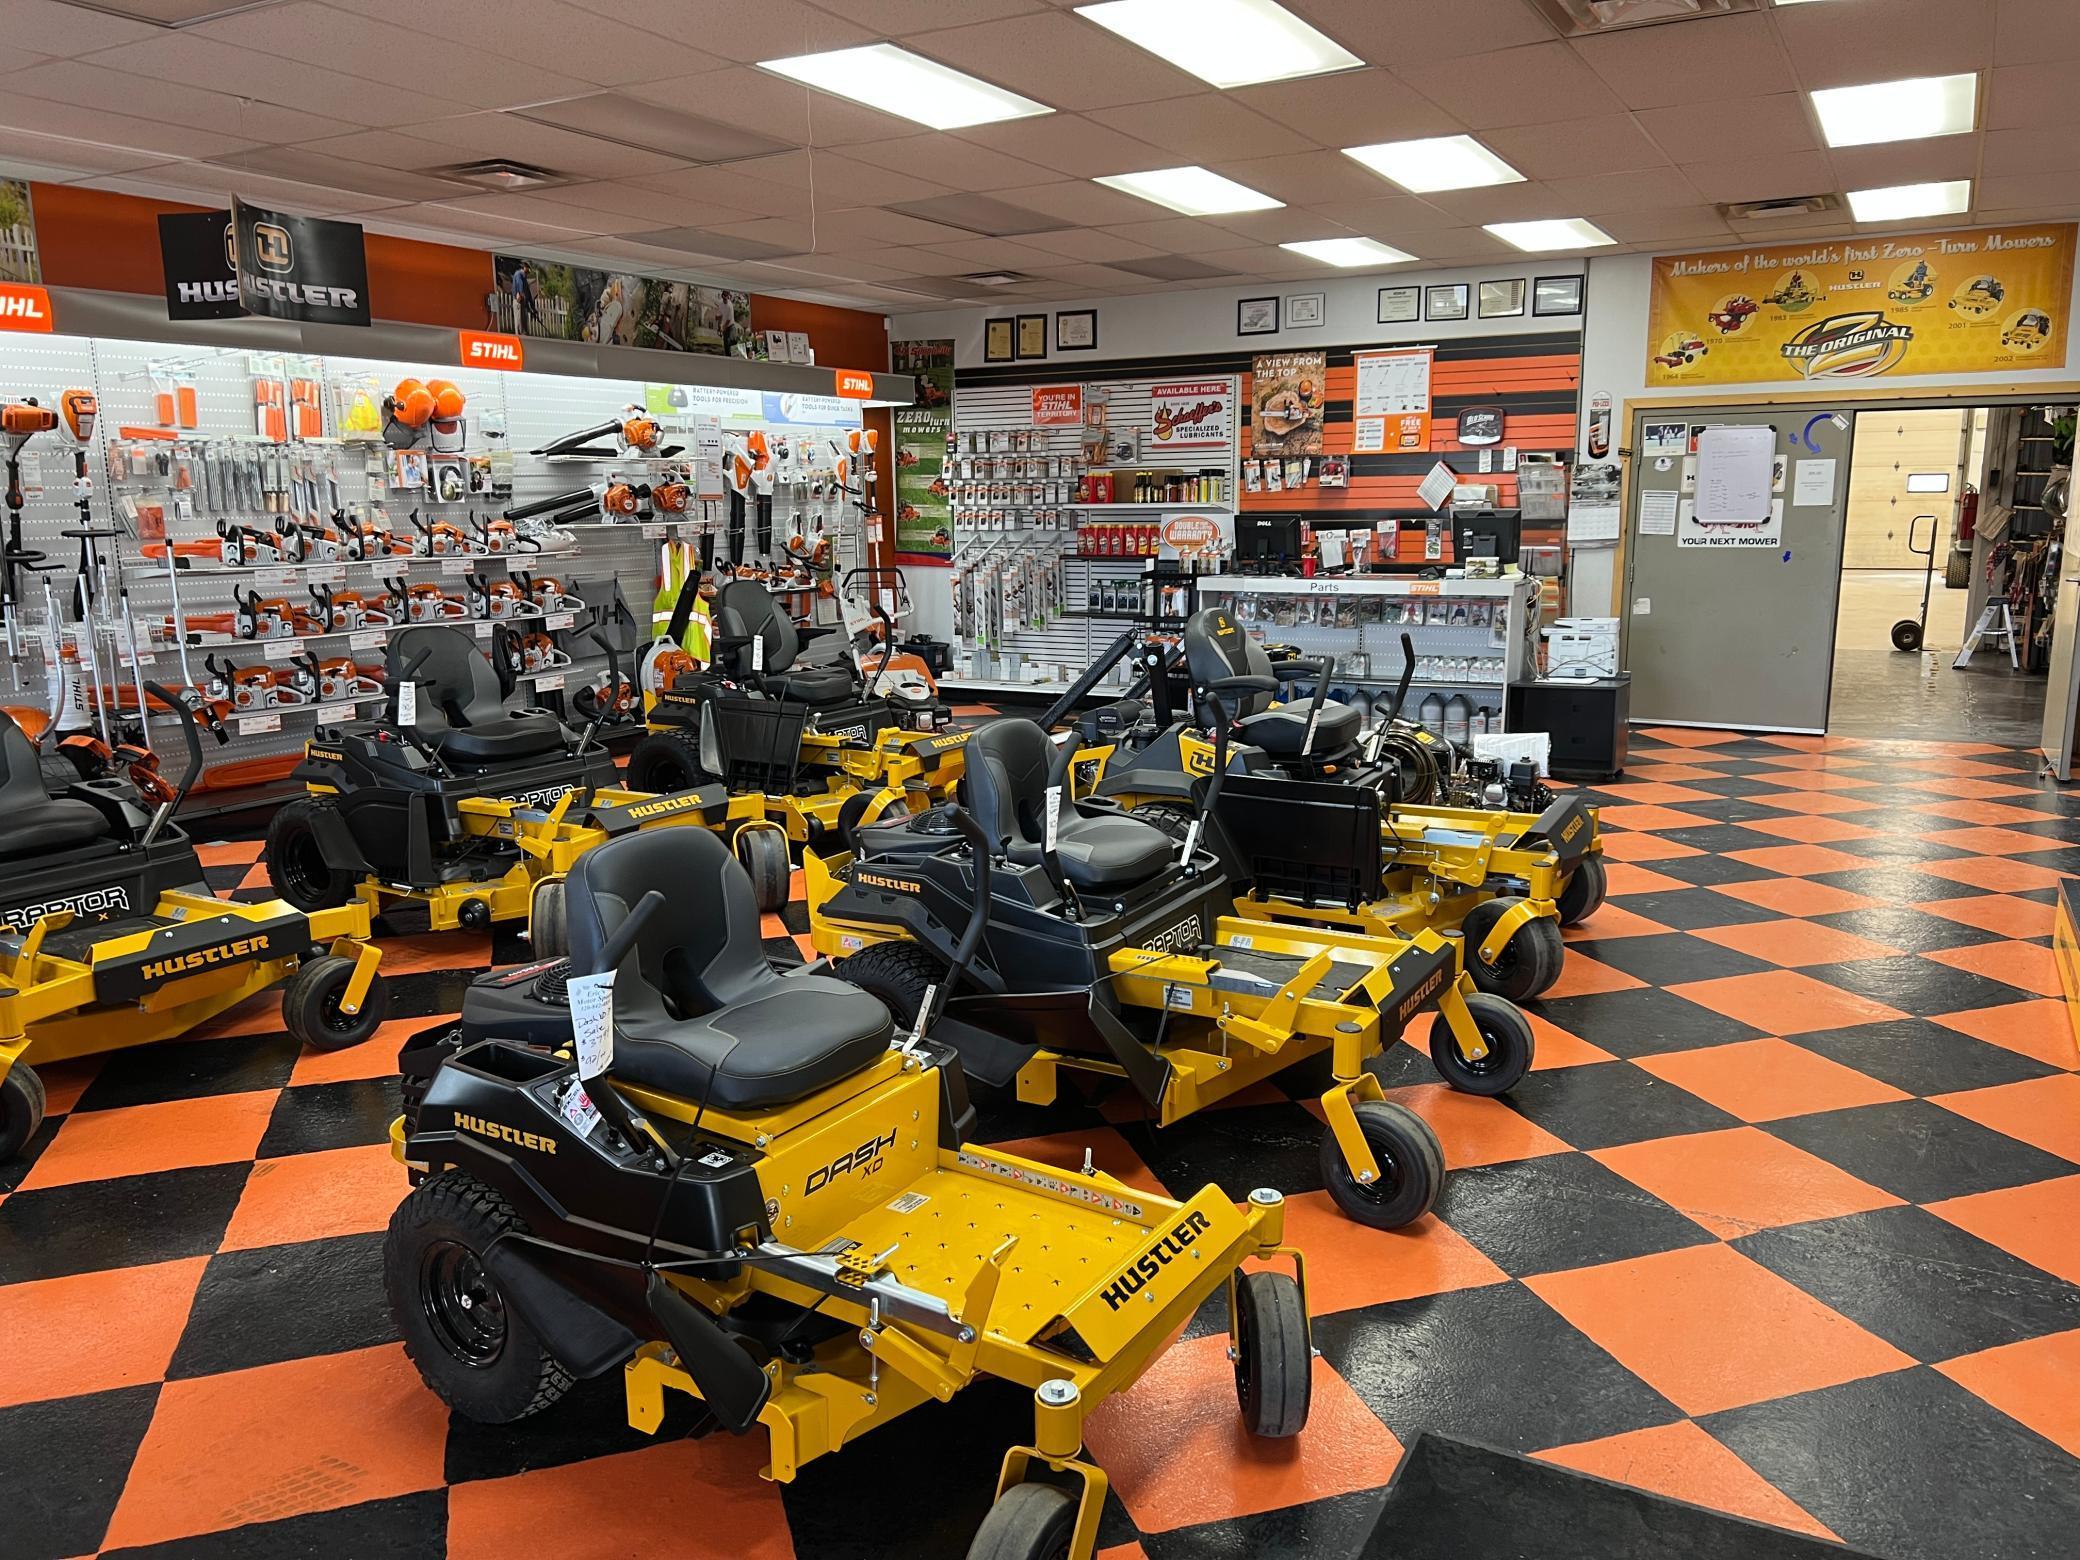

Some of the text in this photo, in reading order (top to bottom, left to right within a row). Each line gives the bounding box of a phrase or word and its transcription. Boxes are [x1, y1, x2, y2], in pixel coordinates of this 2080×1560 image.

[1670, 260, 1729, 278] Makers
[1734, 254, 1750, 274] of
[1754, 254, 1778, 269] the
[1782, 247, 1841, 267] world's
[1843, 245, 1879, 265] first
[1881, 243, 1925, 259] Zero
[1983, 234, 2056, 251] Mowers
[1829, 282, 1882, 292] HUSTLER
[1784, 326, 1912, 357] THE ORIGINAL
[470, 341, 519, 361] STIHL
[1266, 359, 1291, 367] VIEW
[1293, 357, 1322, 366] FROM
[1994, 355, 2013, 363] 2002
[1256, 368, 1297, 378] THE TOP
[843, 377, 870, 391] STIHL
[1200, 385, 1222, 393] HERE
[1067, 393, 1076, 401] IN
[1041, 401, 1073, 410] STIHL
[897, 411, 950, 426] ZERO turn
[1037, 410, 1077, 418] TERRITORY
[1176, 425, 1220, 433] SPECIALIZED
[1681, 537, 1778, 545] YOUR NEXT MOWER
[1310, 582, 1340, 593] Parts
[1410, 583, 1439, 593] STIHL
[72, 677, 84, 711] STIHL
[664, 694, 696, 704] HUSTLER
[310, 749, 343, 761] HUSTLER
[628, 793, 703, 818] HUSTLER
[858, 873, 921, 893] HUSTLER
[1, 886, 130, 928] RAPTOR
[141, 935, 269, 981] HUSTLER
[1399, 968, 1442, 1021] HUSTLER
[454, 1111, 557, 1155] HUSTLER
[804, 1127, 898, 1197] DASH
[861, 1156, 884, 1180] XD
[1100, 1211, 1211, 1312] HUSTLER
